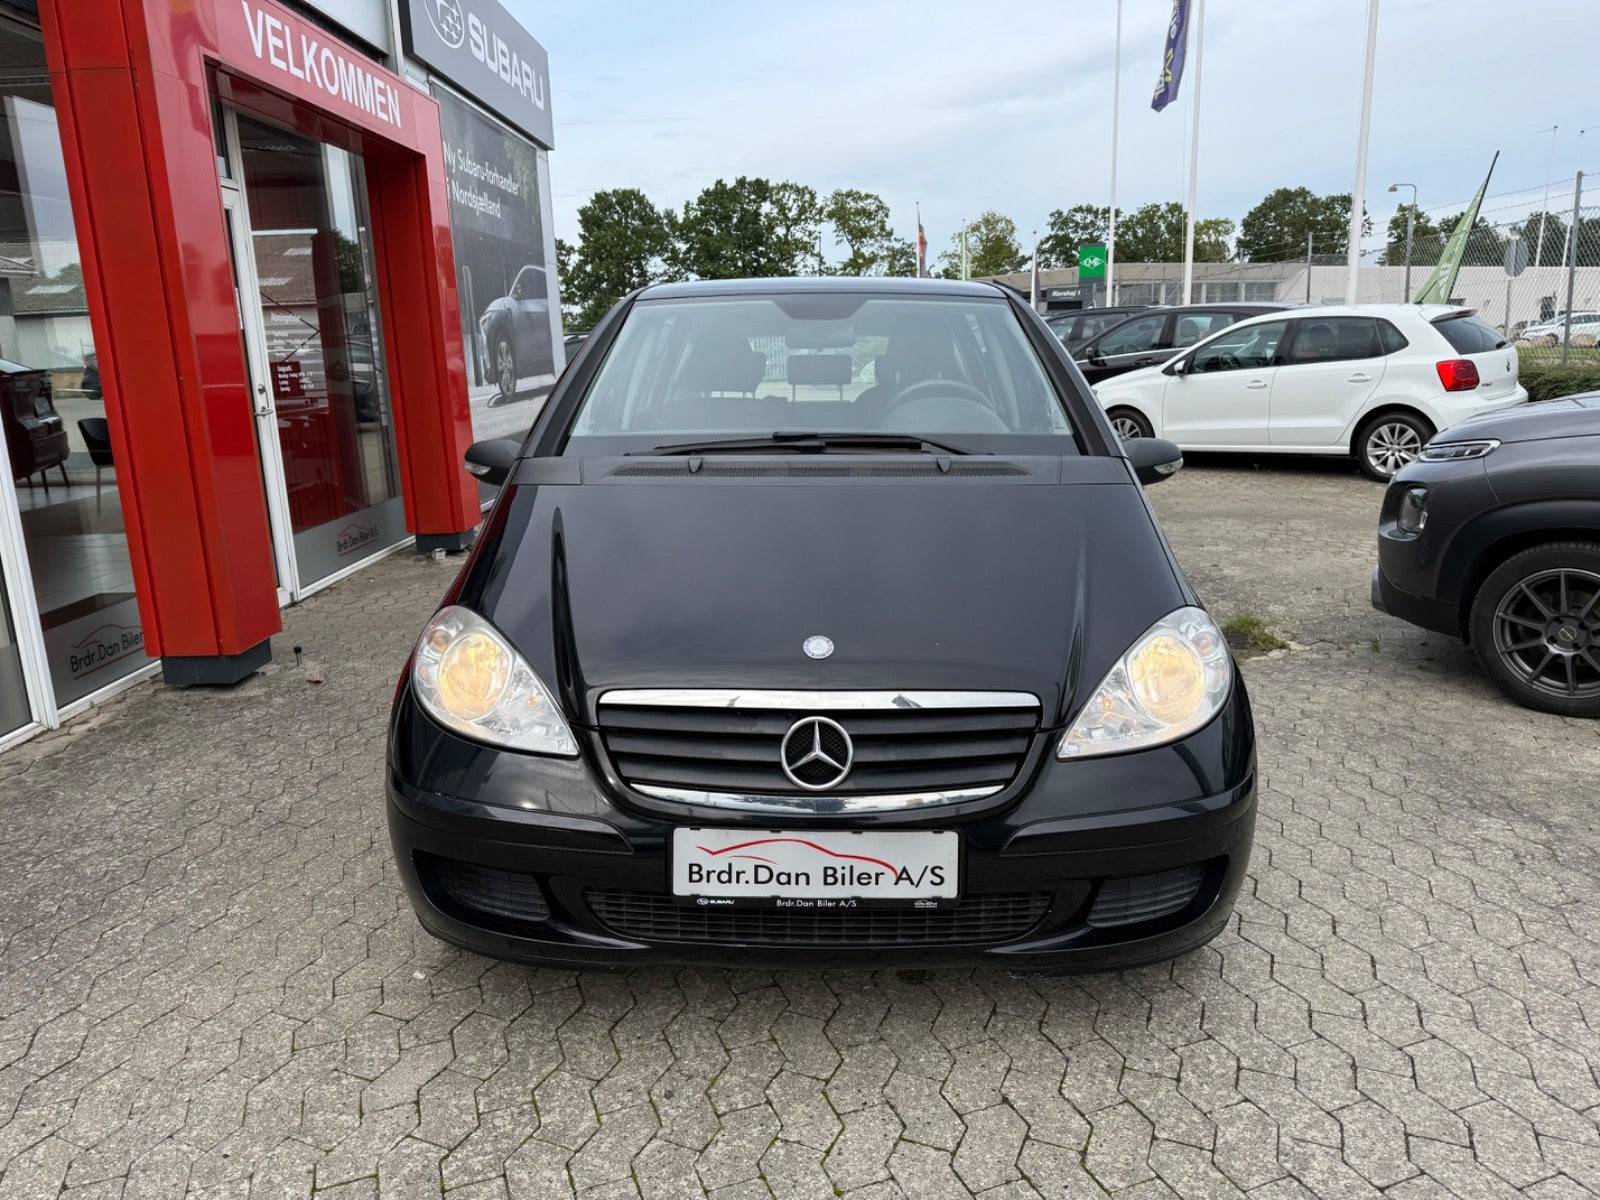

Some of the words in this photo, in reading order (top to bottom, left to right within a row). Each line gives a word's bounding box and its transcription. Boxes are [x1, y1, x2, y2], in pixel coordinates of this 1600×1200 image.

[241, 0, 401, 128] VELKOMMEN
[467, 11, 545, 111] SUBARU
[457, 148, 519, 196] Subaru-forhandler
[451, 179, 502, 218] Nordsjælland
[70, 642, 121, 673] Brdr.Dan
[121, 631, 144, 650] Biler
[688, 862, 811, 886] Brdr.Dan
[823, 865, 885, 886] Biler
[893, 865, 946, 888] A/S
[817, 900, 837, 908] Biler
[838, 900, 857, 909] A/S
